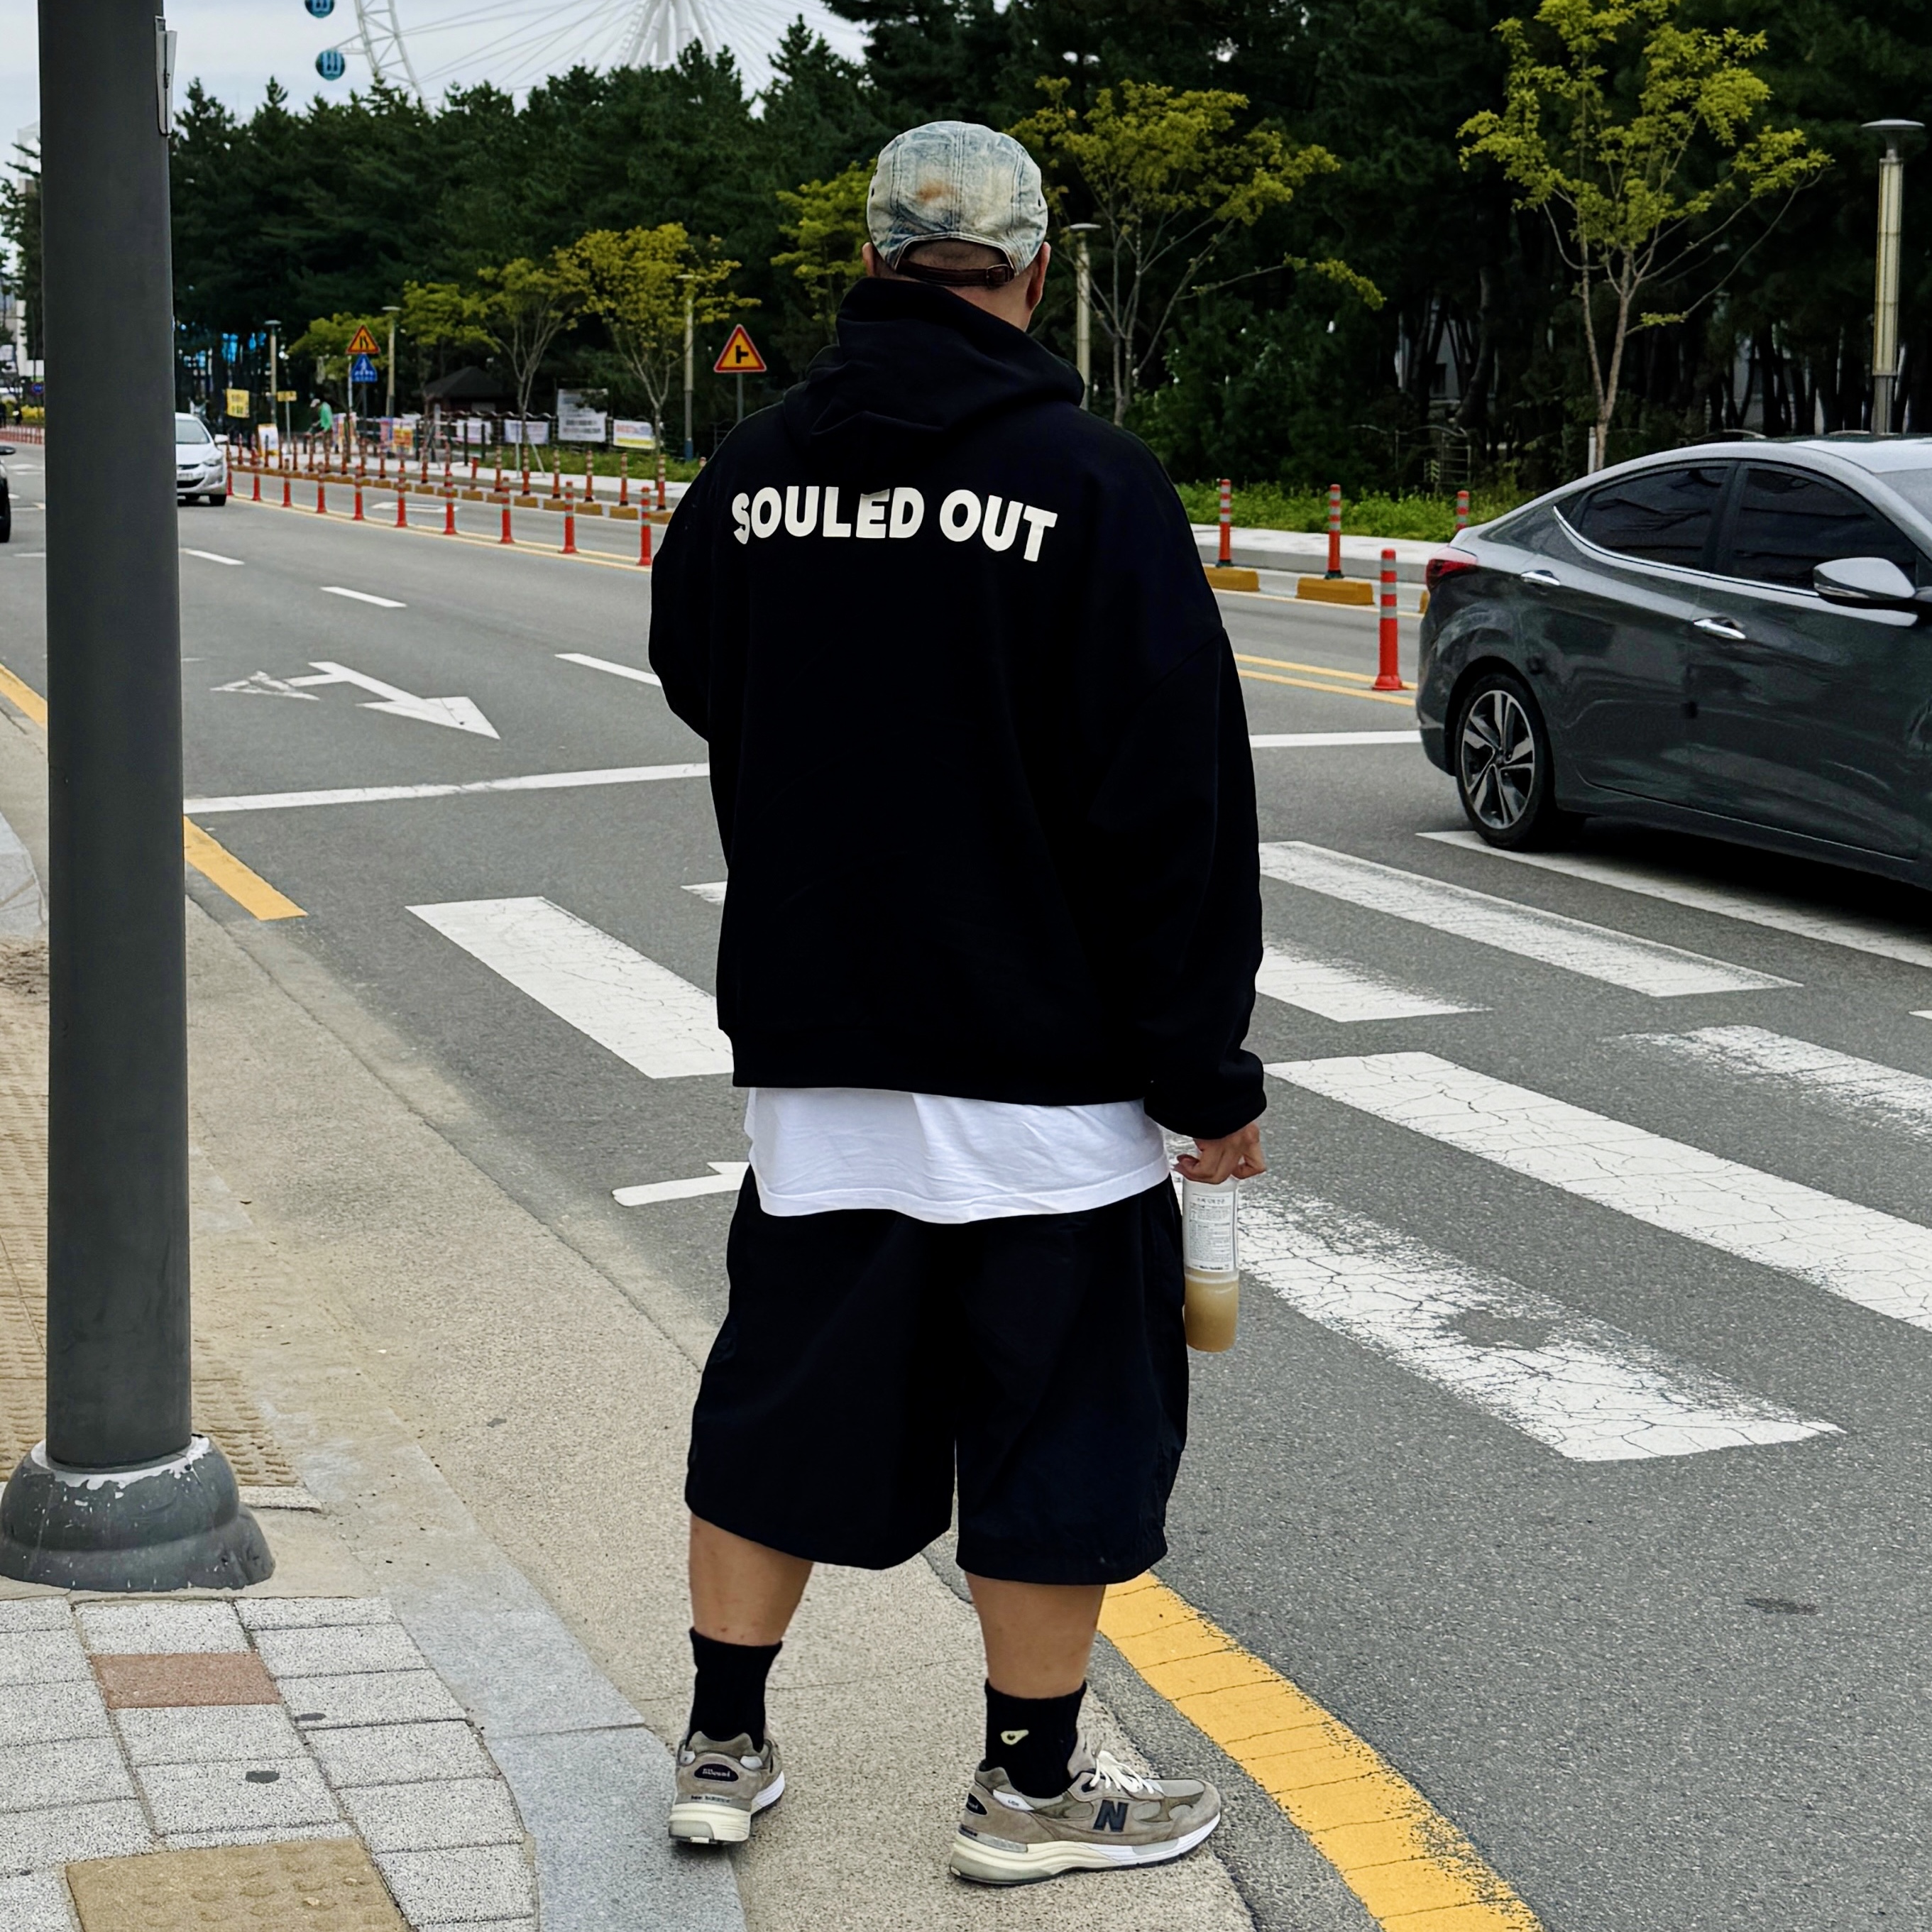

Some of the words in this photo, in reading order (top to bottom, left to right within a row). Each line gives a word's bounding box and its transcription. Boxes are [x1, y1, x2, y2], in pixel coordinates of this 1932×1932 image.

[732, 486, 925, 544] SOULED
[940, 489, 1058, 561] OUT
[1093, 1799, 1129, 1832] N
